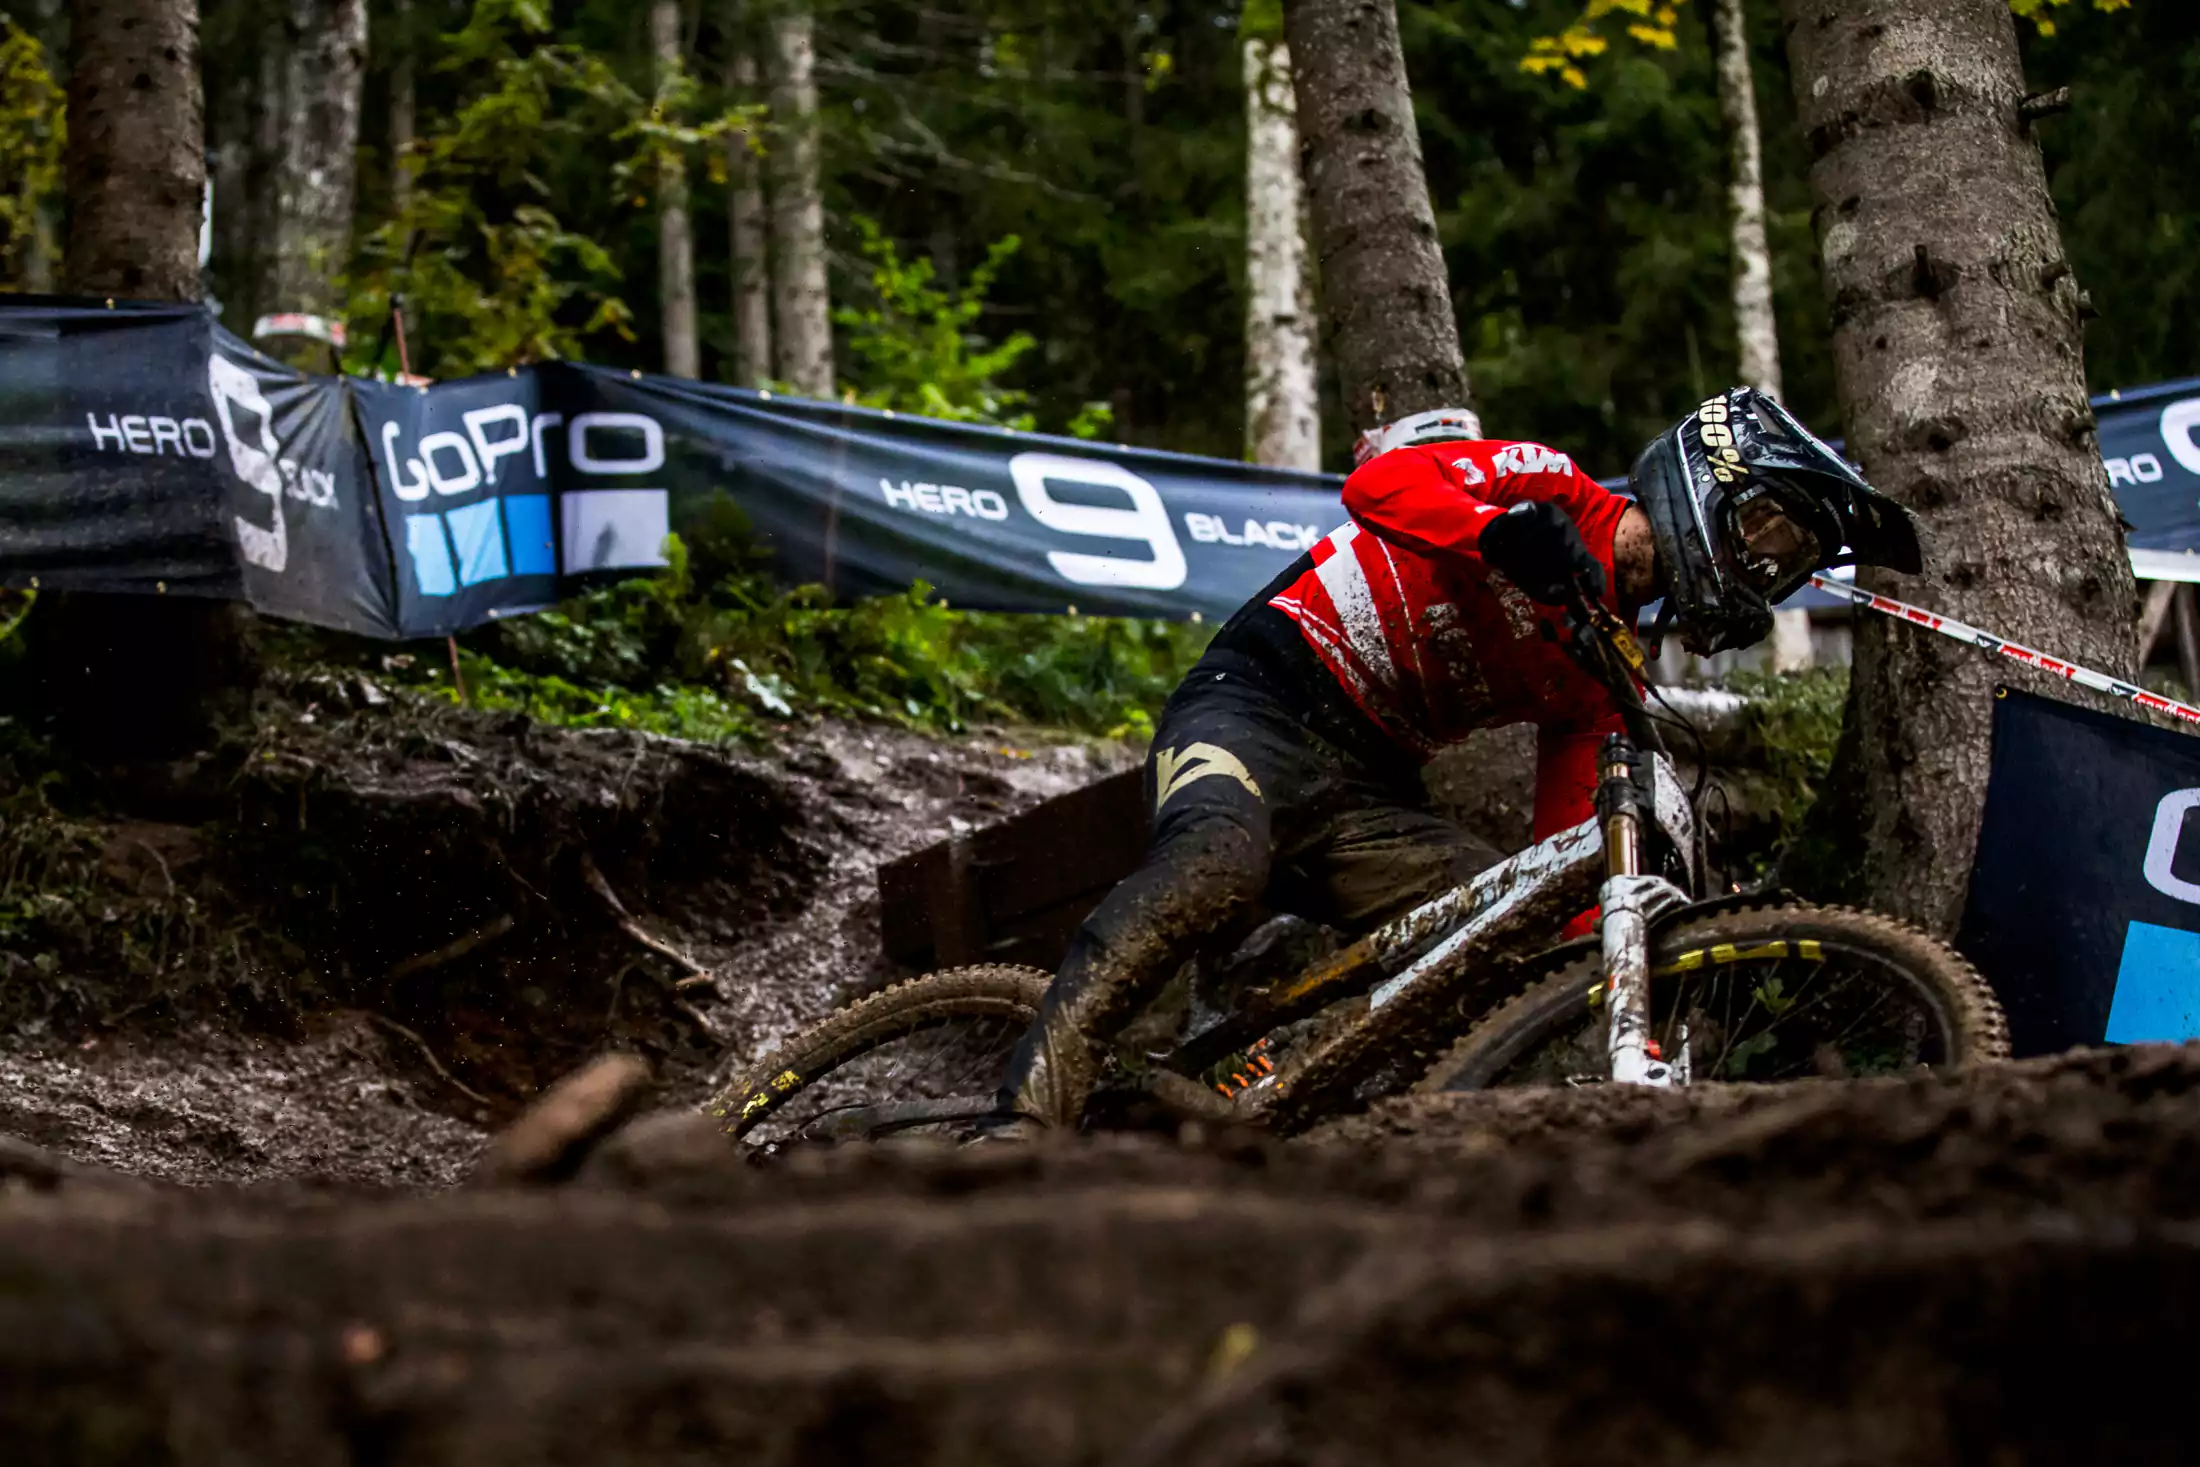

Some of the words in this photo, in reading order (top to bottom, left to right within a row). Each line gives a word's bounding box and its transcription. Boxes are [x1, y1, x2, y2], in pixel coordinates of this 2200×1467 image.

[86, 412, 216, 458] HERO
[382, 403, 665, 501] GoPro
[1699, 395, 1750, 483] 100%
[2103, 452, 2164, 488] RO
[879, 478, 1009, 521] HERO
[1008, 452, 1187, 590] 9
[1184, 512, 1319, 551] BLACK
